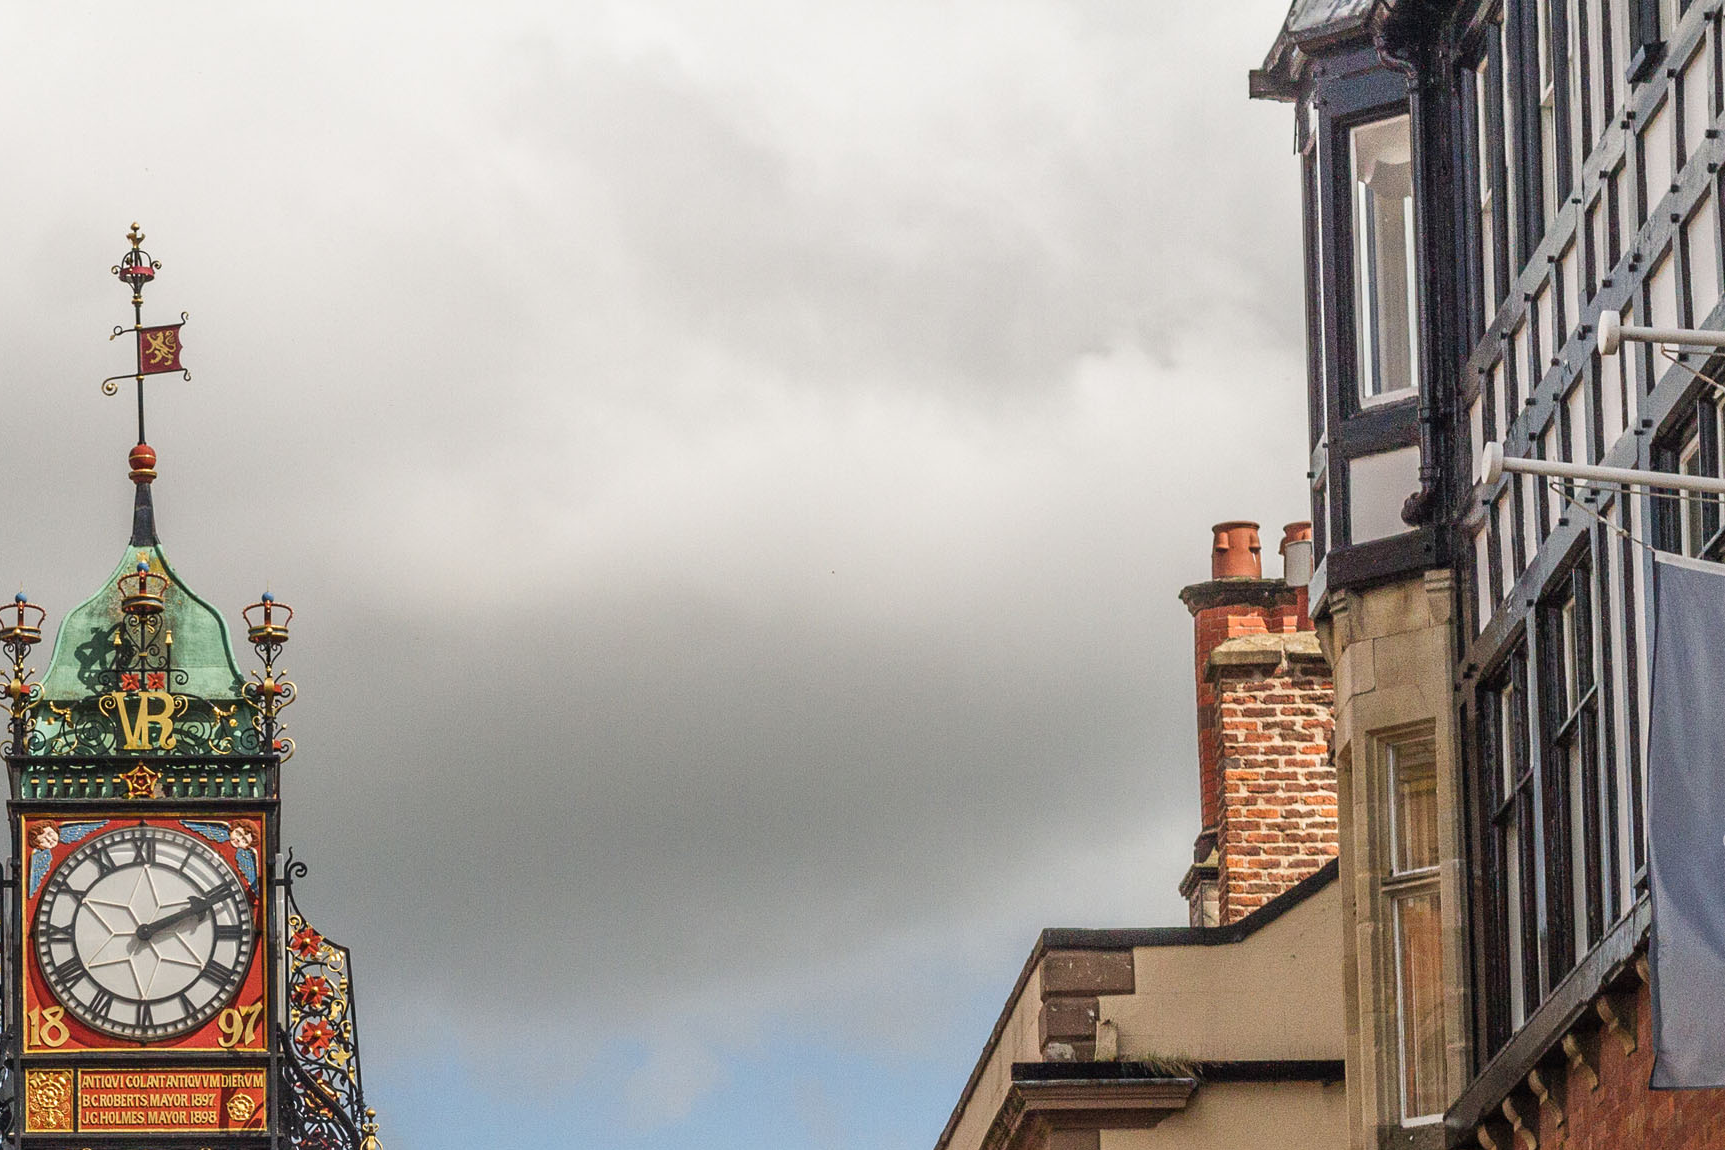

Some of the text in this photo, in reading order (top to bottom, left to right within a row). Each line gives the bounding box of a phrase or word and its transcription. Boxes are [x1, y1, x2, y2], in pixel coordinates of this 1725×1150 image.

[112, 690, 177, 750] VR
[27, 1001, 263, 1048] 18 97
[81, 1074, 264, 1088] ANTIQVI COLANT ANTIQVVM DIERVM
